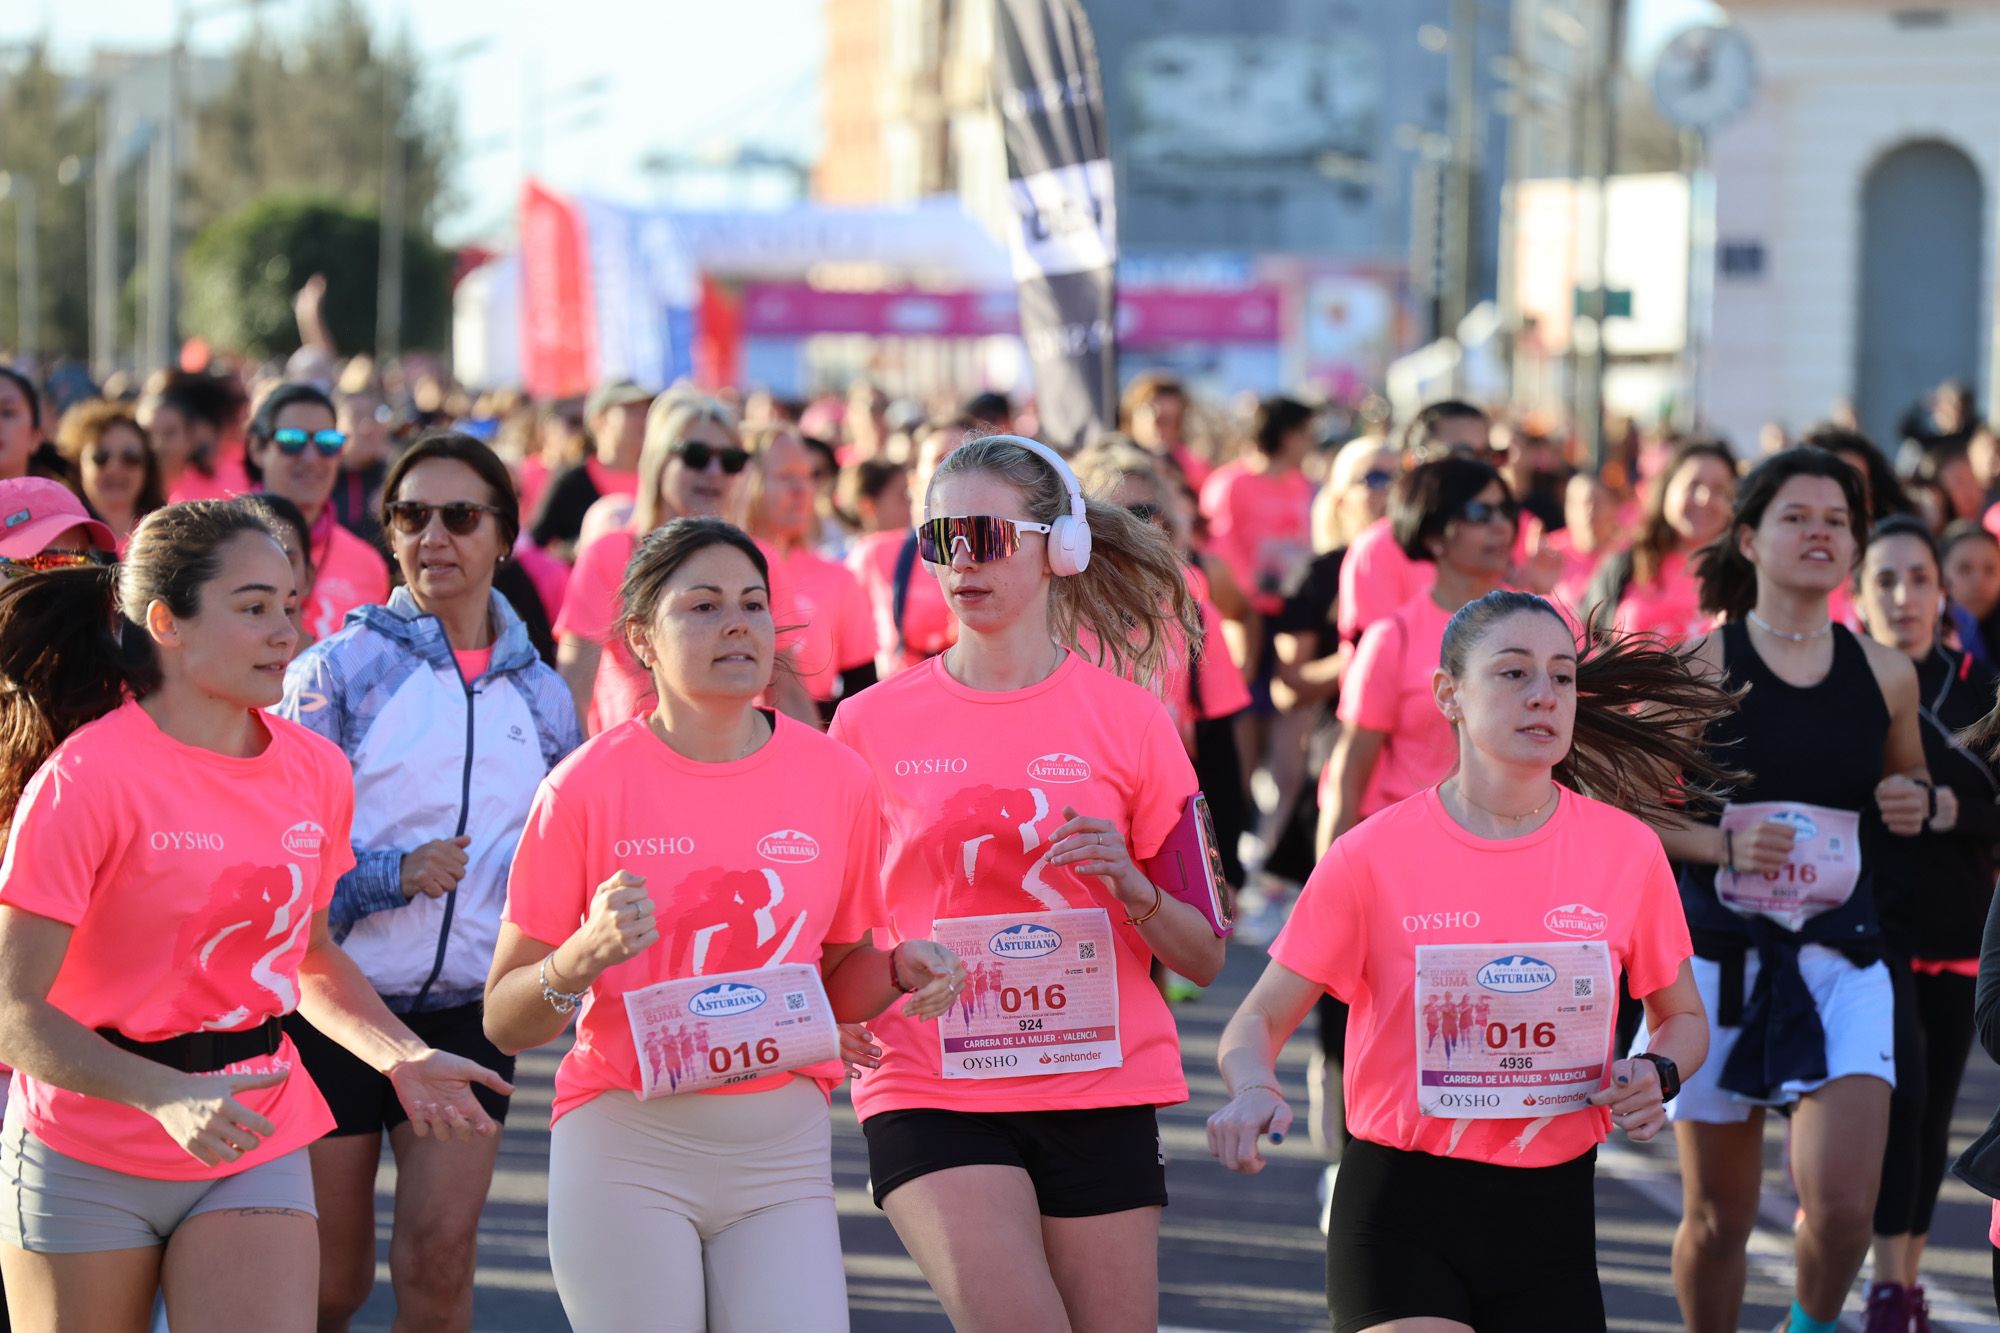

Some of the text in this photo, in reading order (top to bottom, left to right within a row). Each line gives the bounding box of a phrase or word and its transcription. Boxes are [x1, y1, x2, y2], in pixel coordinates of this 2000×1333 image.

[894, 757, 968, 776] OYSHO
[1031, 763, 1088, 778] ASTURIANA
[150, 831, 225, 851] OYSHO
[613, 836, 695, 858] OYSHO
[762, 841, 817, 858] ASTURIANA
[1402, 910, 1481, 933] OYSHO
[994, 937, 1058, 951] ASTURIANA
[1431, 976, 1470, 987] SUMA
[1482, 969, 1552, 984] ASTURIANA
[695, 994, 763, 1012] ASTURIANA
[1000, 984, 1067, 1013] 016
[646, 1008, 683, 1026] SUMA
[1018, 1018, 1043, 1031] 924
[964, 1030, 1098, 1049] CARRERA DE LA MUJER VALENCIA
[1485, 1021, 1557, 1049] 016
[708, 1037, 780, 1074] 016
[962, 1054, 1018, 1070] OYSHO
[1053, 1051, 1102, 1064] Santander
[1498, 1056, 1533, 1070] 4936
[1443, 1070, 1587, 1085] CARRERA DE LA MUJER VALENCIA
[1440, 1093, 1500, 1107] OYSHO
[1537, 1091, 1587, 1106] Santander
